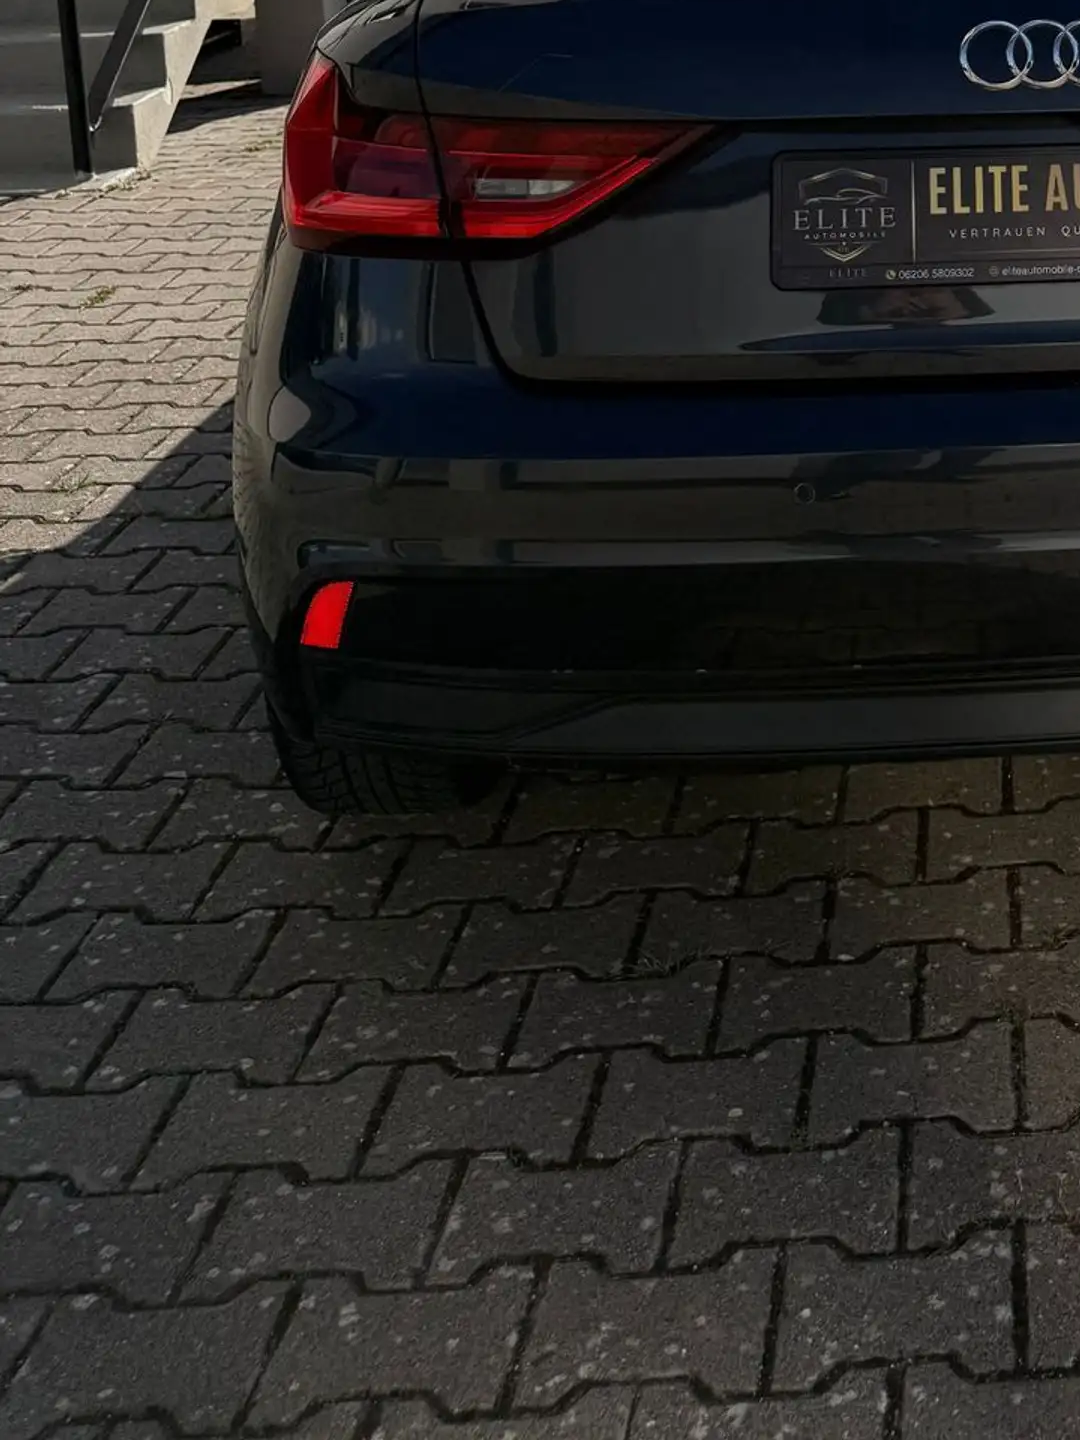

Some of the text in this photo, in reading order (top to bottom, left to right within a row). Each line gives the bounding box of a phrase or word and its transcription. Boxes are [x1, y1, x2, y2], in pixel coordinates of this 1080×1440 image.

[929, 164, 1030, 215] ELITE
[792, 206, 897, 231] ELITE
[949, 226, 1047, 240] VERTRAUEN
